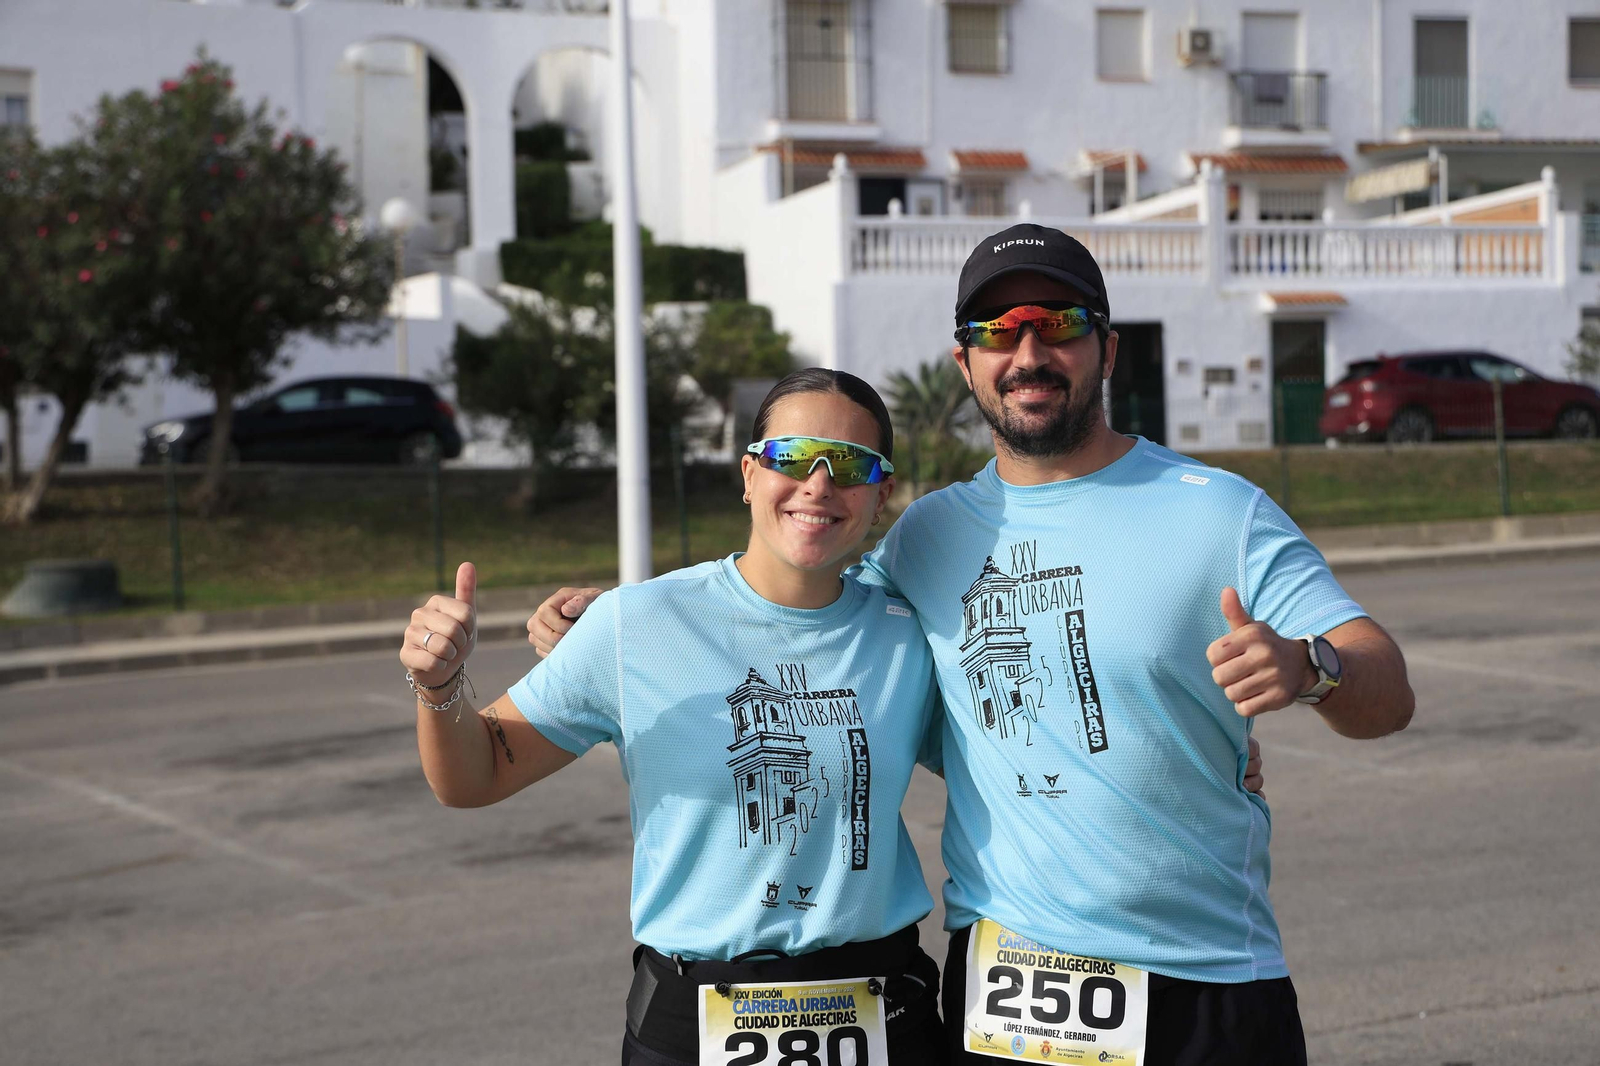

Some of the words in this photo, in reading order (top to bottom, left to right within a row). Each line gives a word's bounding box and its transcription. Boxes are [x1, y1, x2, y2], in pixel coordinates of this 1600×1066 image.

[993, 239, 1045, 253] KIPRUN
[1010, 540, 1037, 575] XXV
[1021, 565, 1083, 584] CARRERA
[1019, 578, 1083, 615] URBANA
[776, 664, 808, 691] XXV
[1067, 613, 1104, 749] ALGECIRAS
[793, 688, 857, 699] CARRERA
[793, 699, 863, 727] URBANA
[851, 731, 868, 866] ALGECIRAS
[997, 950, 1036, 967] CIUDAD
[1038, 955, 1053, 969] DE
[1053, 956, 1116, 976] ALGECIRAS
[732, 998, 798, 1015] CARRERA
[799, 995, 856, 1013] URBANA
[734, 991, 750, 999] XXV
[752, 988, 783, 999] EDICIÓN
[986, 965, 1127, 1030] 250
[734, 1015, 780, 1030] CIUDAD
[782, 1014, 798, 1028] DE
[799, 1010, 857, 1027] ALGECIRAS
[1003, 1021, 1023, 1034] LÓPEZ
[1024, 1026, 1062, 1040] FERNÁNDEZ,
[1064, 1031, 1097, 1043] GERARDO
[725, 1026, 869, 1066] 280
[1055, 1046, 1085, 1054] Ayuntamiento
